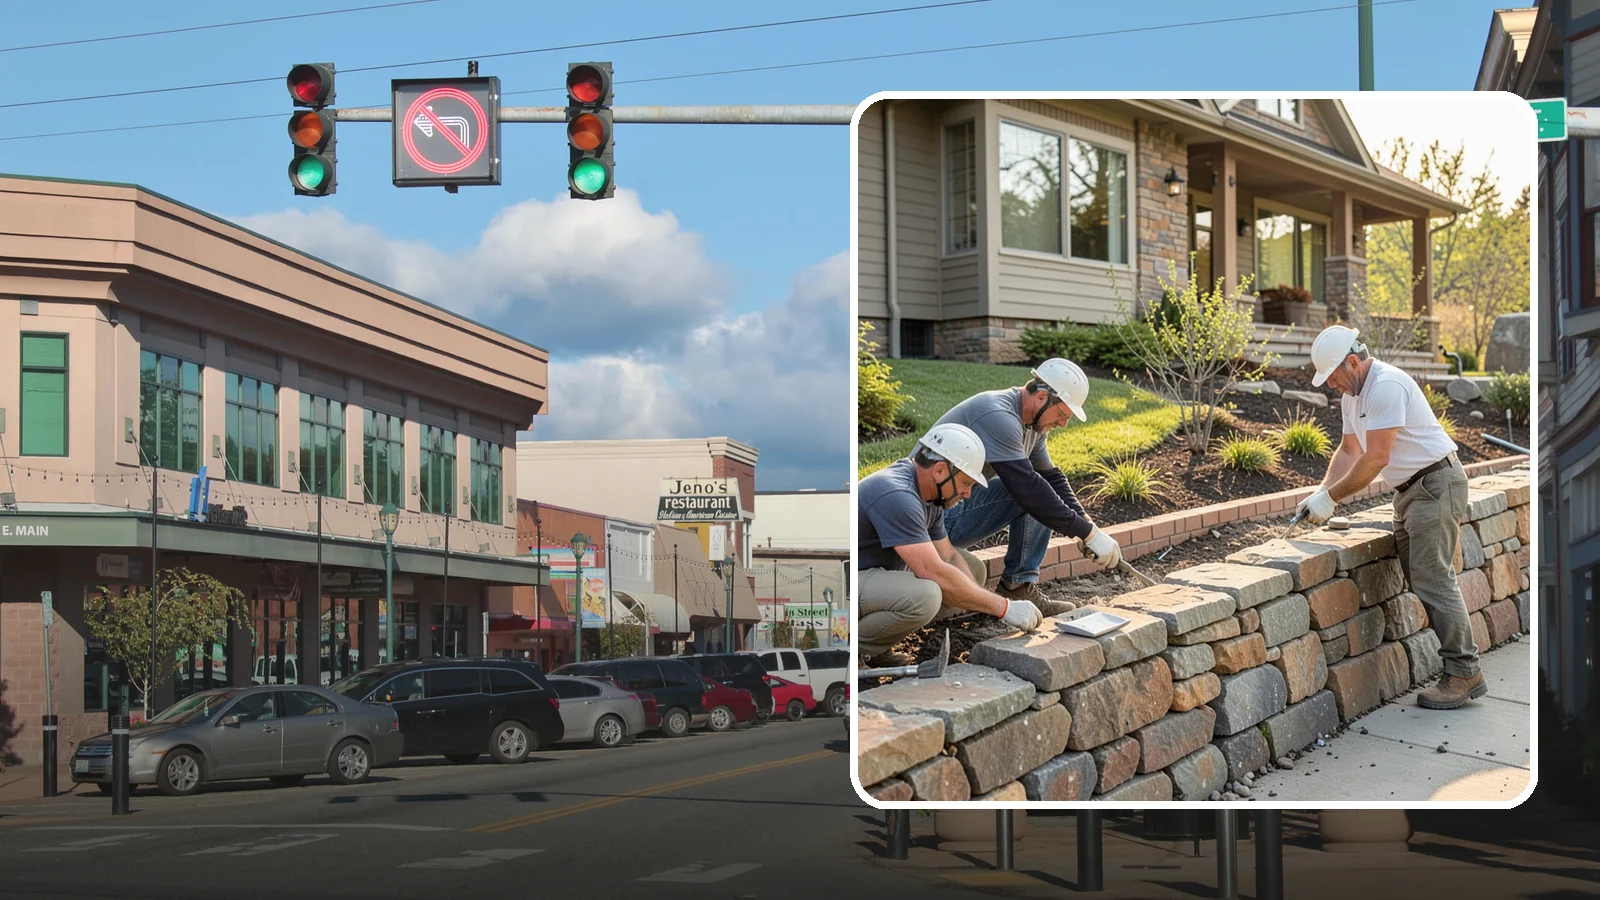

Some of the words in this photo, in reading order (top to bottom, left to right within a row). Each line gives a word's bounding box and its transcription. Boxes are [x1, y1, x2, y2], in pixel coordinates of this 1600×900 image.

[670, 480, 727, 494] Jeno's
[665, 496, 731, 509] restaurant
[659, 509, 681, 520] Italian
[685, 509, 715, 520] American
[715, 509, 738, 519] Cuisine
[2, 525, 13, 536] E.
[15, 525, 49, 536] MAIN
[797, 607, 828, 616] Street
[791, 619, 823, 627] lass
